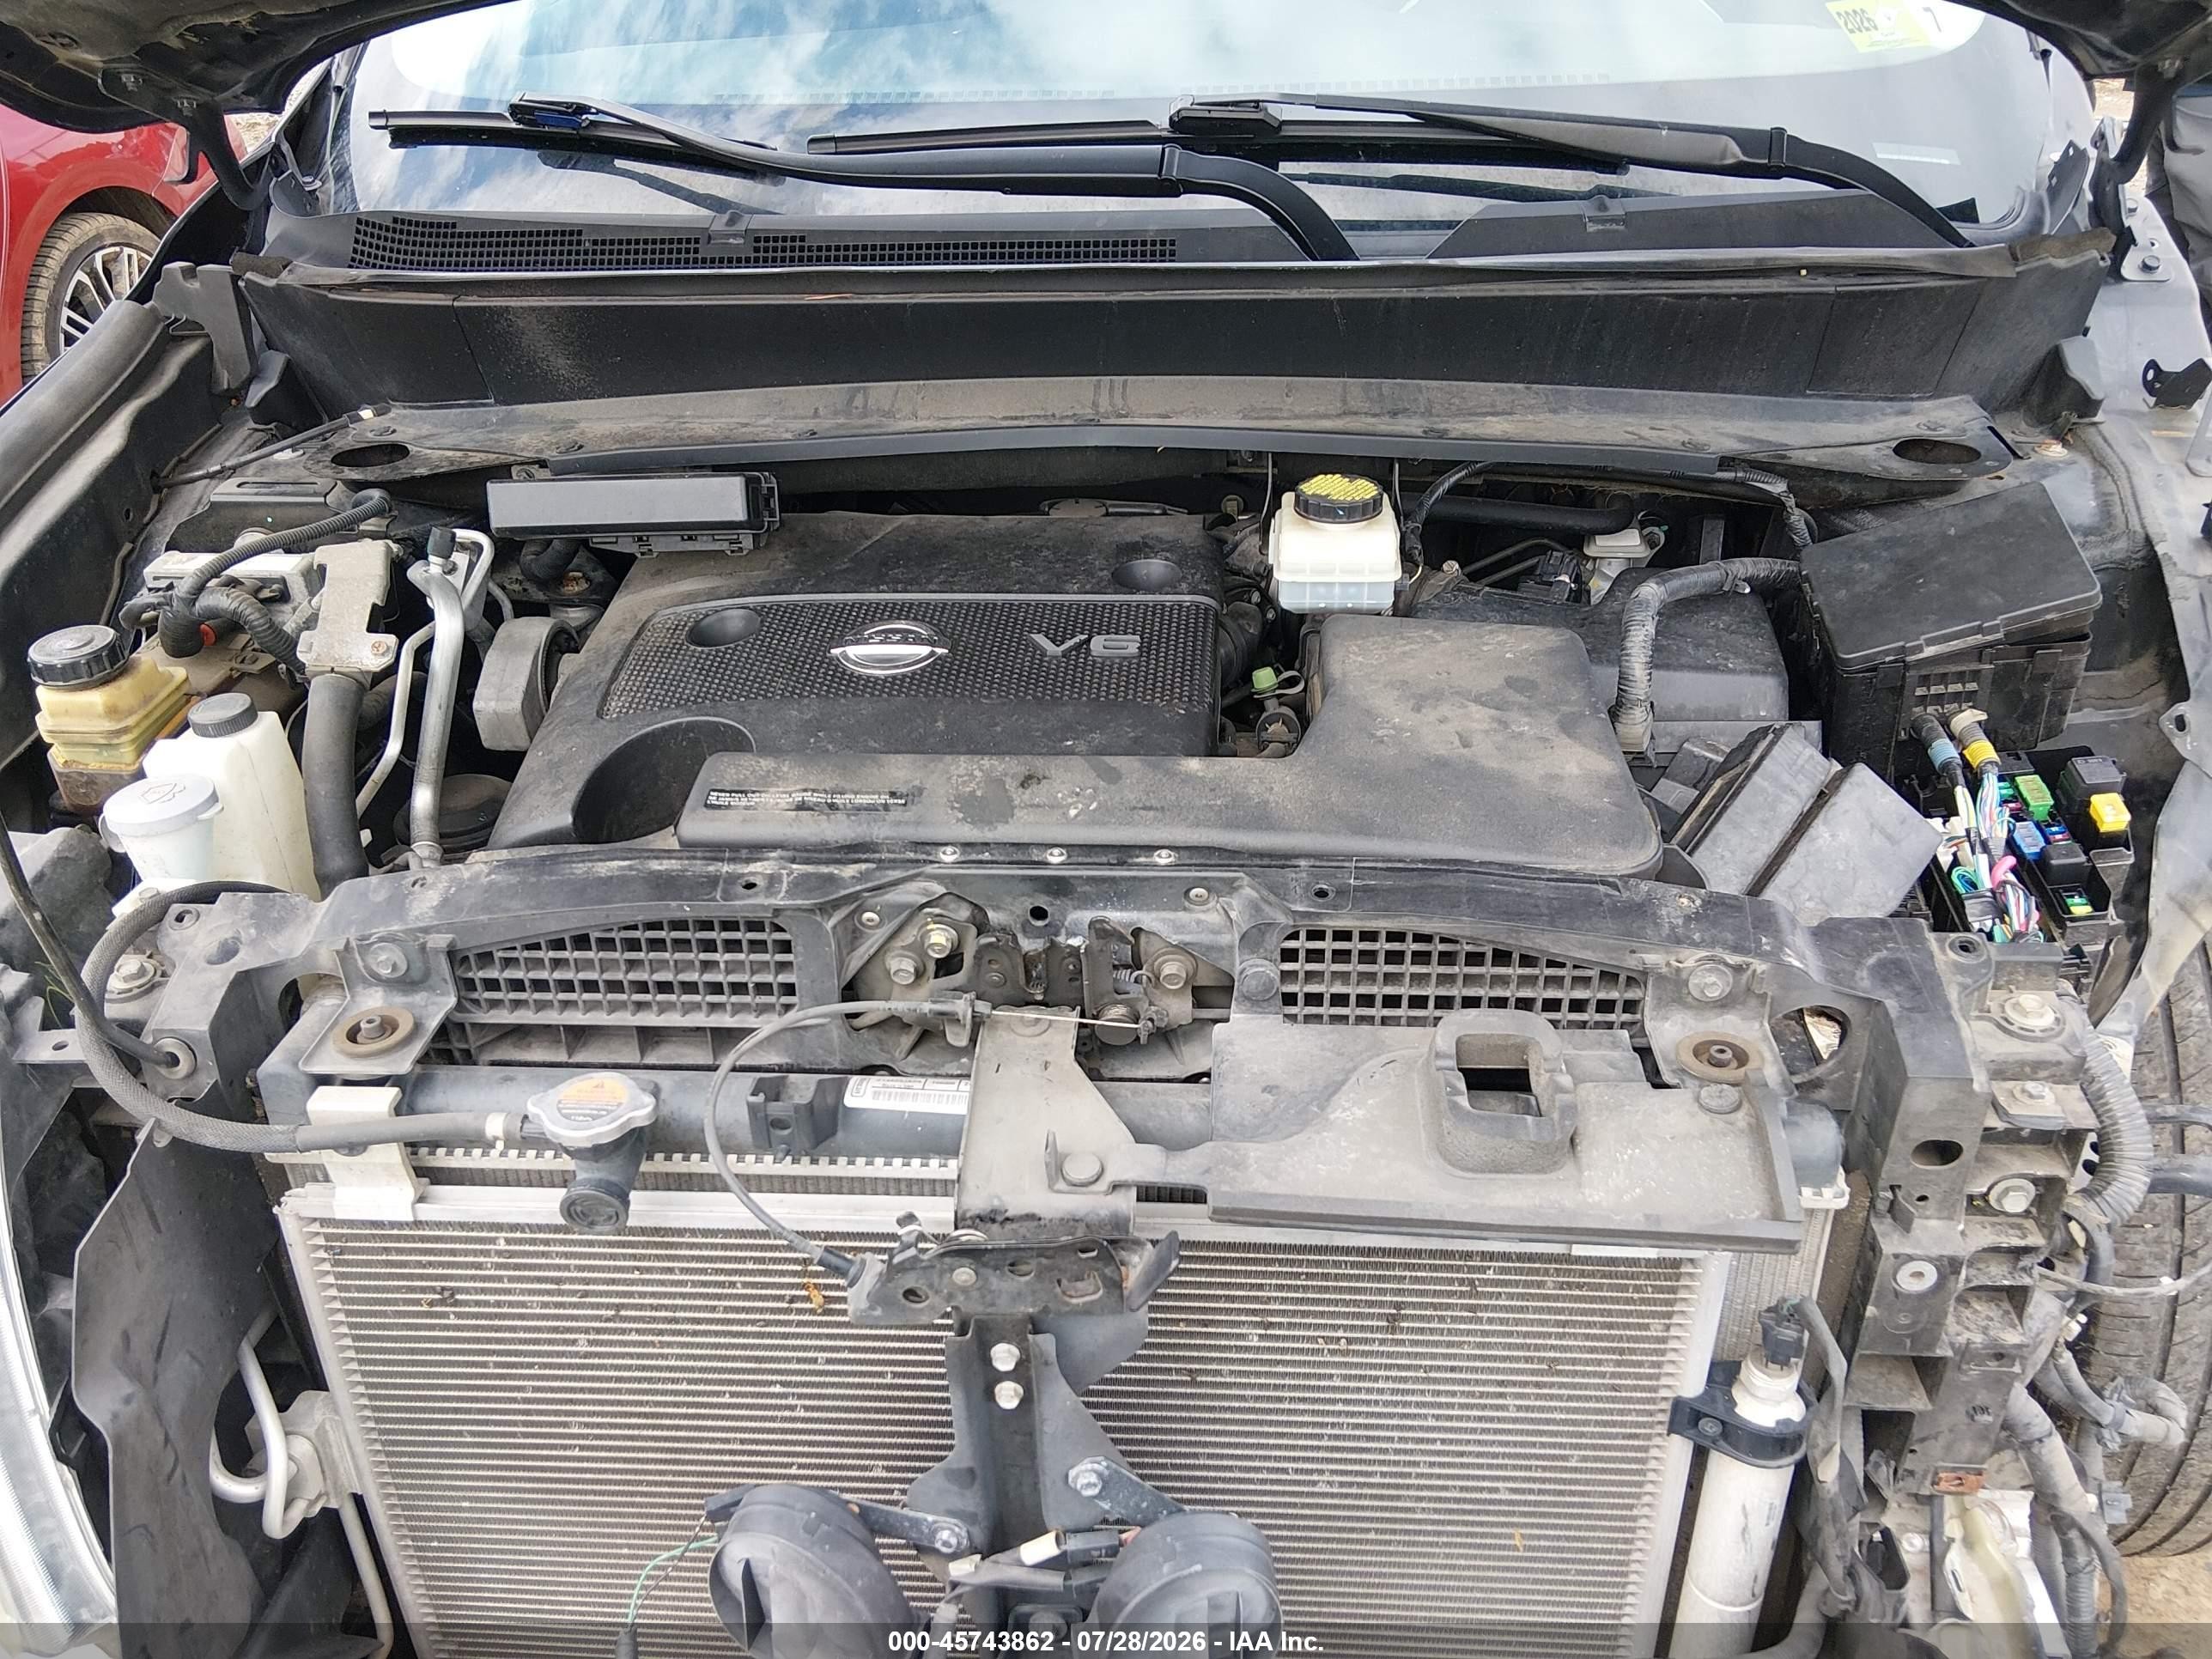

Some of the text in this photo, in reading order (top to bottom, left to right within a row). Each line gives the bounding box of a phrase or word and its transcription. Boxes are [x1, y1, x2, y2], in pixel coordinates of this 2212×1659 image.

[1835, 6, 1942, 34] 2026 7
[1030, 634, 1140, 657] V6
